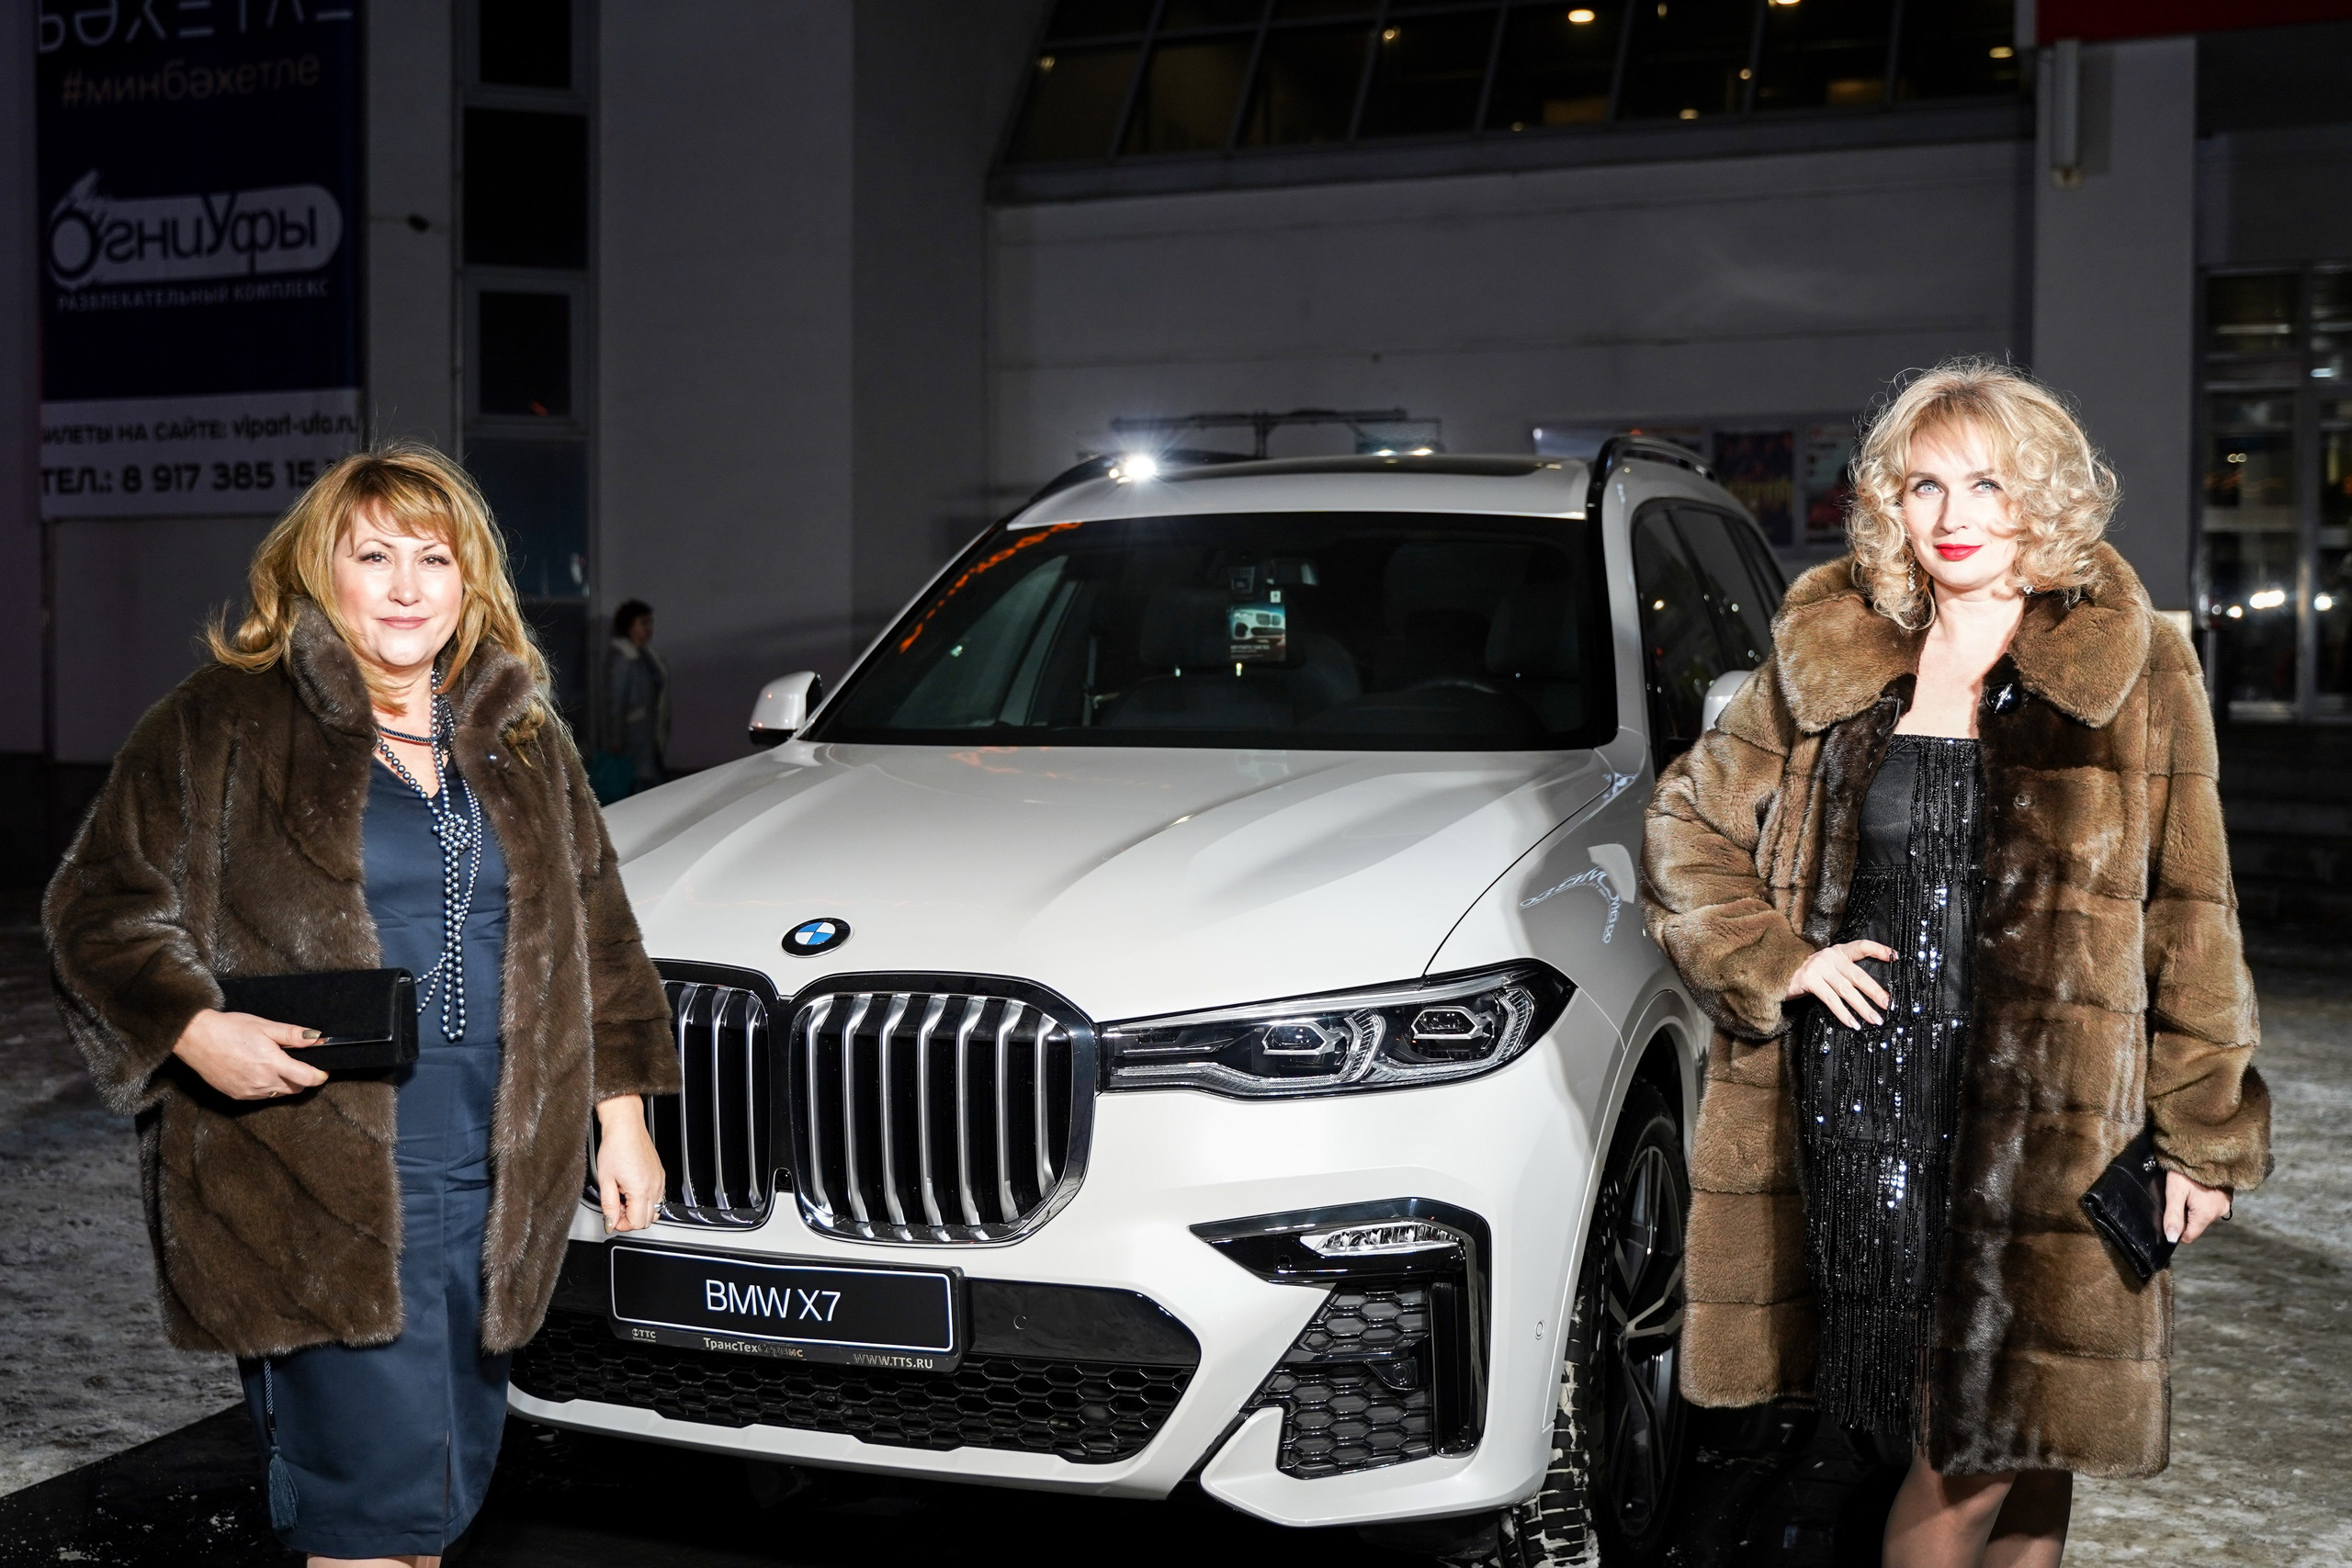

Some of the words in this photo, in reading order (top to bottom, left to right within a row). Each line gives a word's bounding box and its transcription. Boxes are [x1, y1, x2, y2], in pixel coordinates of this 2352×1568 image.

[232, 276, 329, 302] КОМПЛЕКС
[43, 423, 113, 445] ИЛЕТЫ
[119, 423, 148, 442] НА
[122, 466, 141, 492] 8
[153, 464, 201, 492] 917
[212, 461, 274, 491] 385
[286, 459, 314, 488] 15
[705, 1279, 791, 1319] BMW
[798, 1288, 842, 1323] X7
[853, 1353, 933, 1370] WWW.TTS.RU
